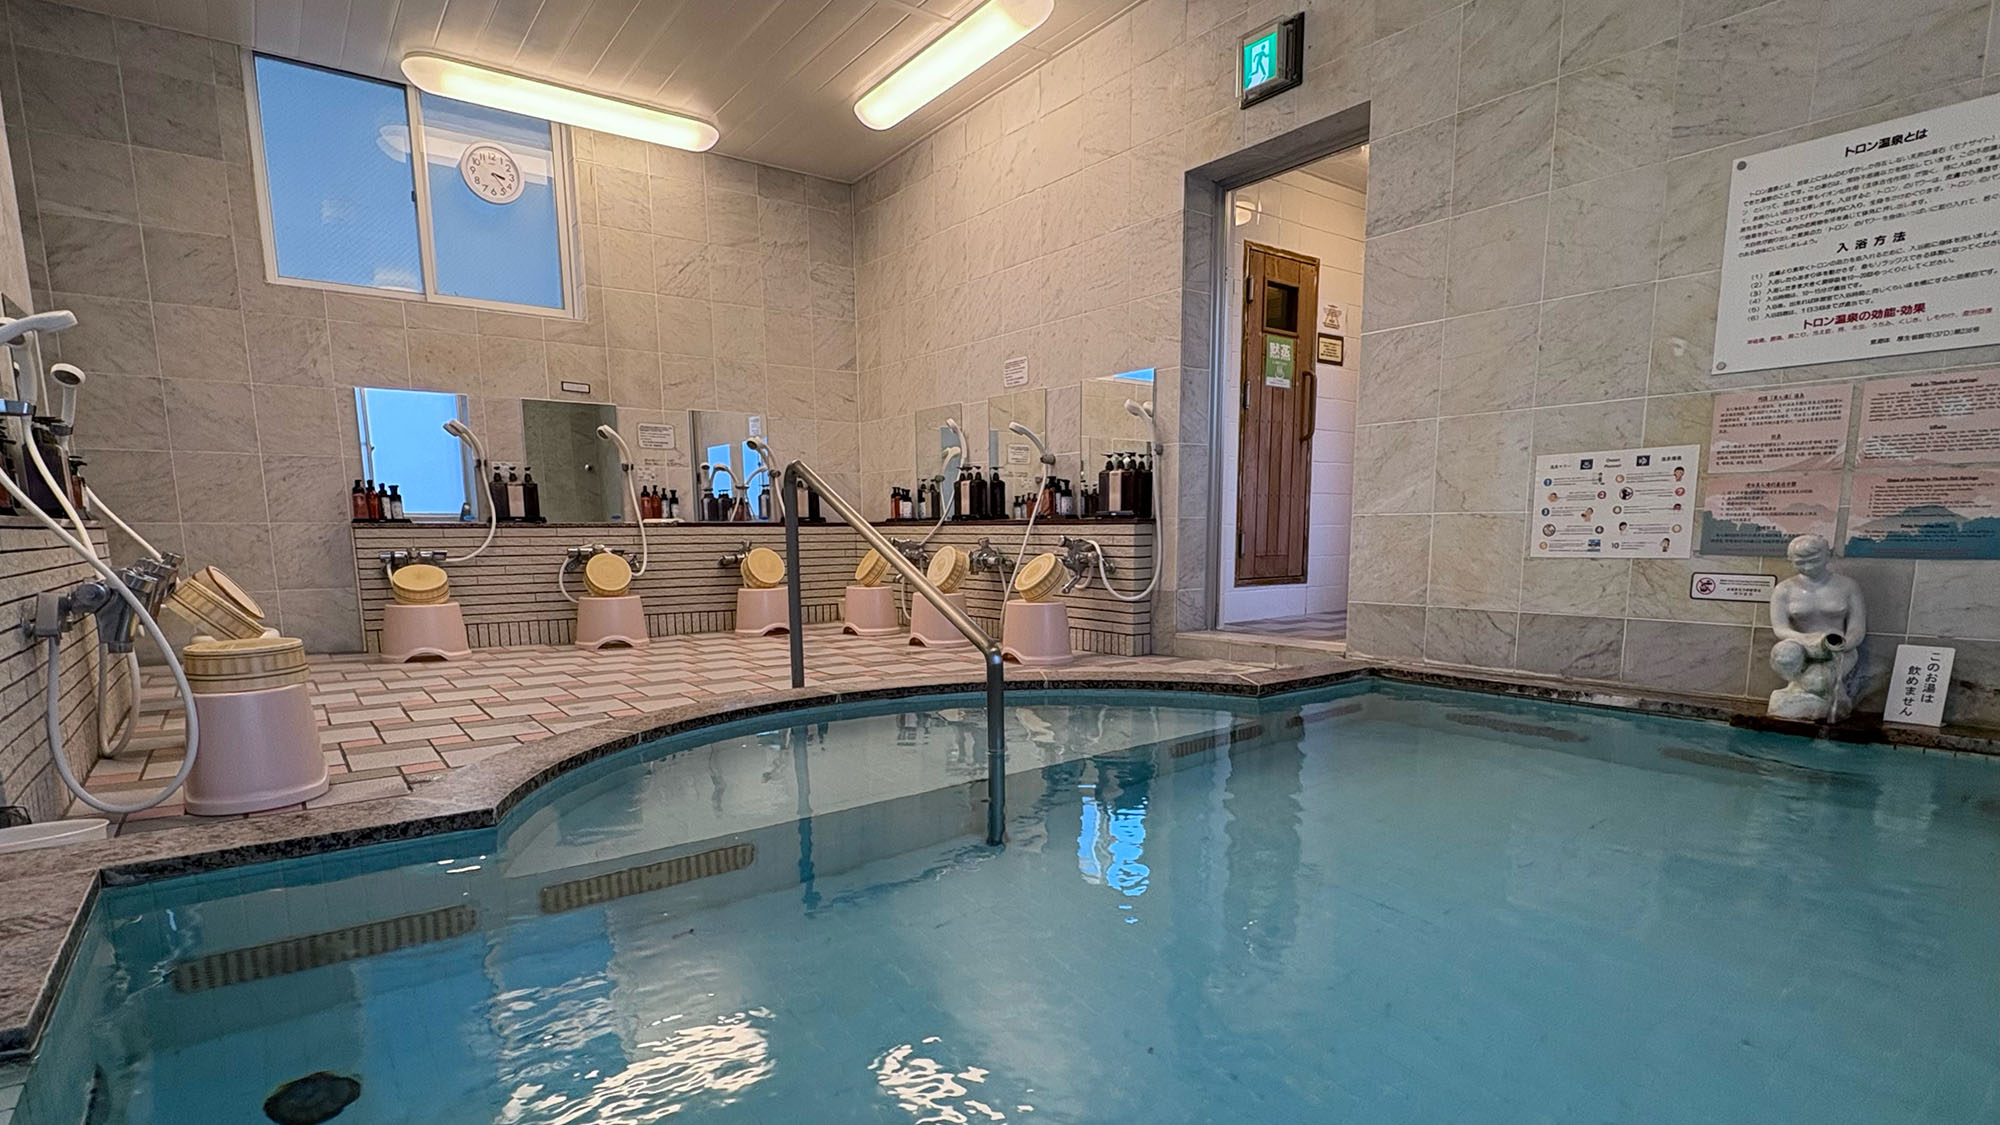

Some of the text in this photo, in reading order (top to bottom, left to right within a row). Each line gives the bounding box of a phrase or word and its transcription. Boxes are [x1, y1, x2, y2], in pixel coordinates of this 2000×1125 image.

[1845, 127, 1927, 157] トロン温泉とは
[480, 153, 486, 161] 11
[488, 152, 496, 161] 12
[472, 157, 480, 166] 10
[470, 166, 476, 174] 9
[505, 164, 512, 172] 2
[474, 176, 480, 184] 8
[509, 174, 515, 182] 3
[482, 184, 488, 192] 7
[491, 188, 497, 196] 6
[500, 187, 507, 196] 5
[1837, 230, 1906, 253] 入浴方法
[1920, 652, 1941, 704] このお湯は
[1898, 665, 1922, 718] 飲めません
